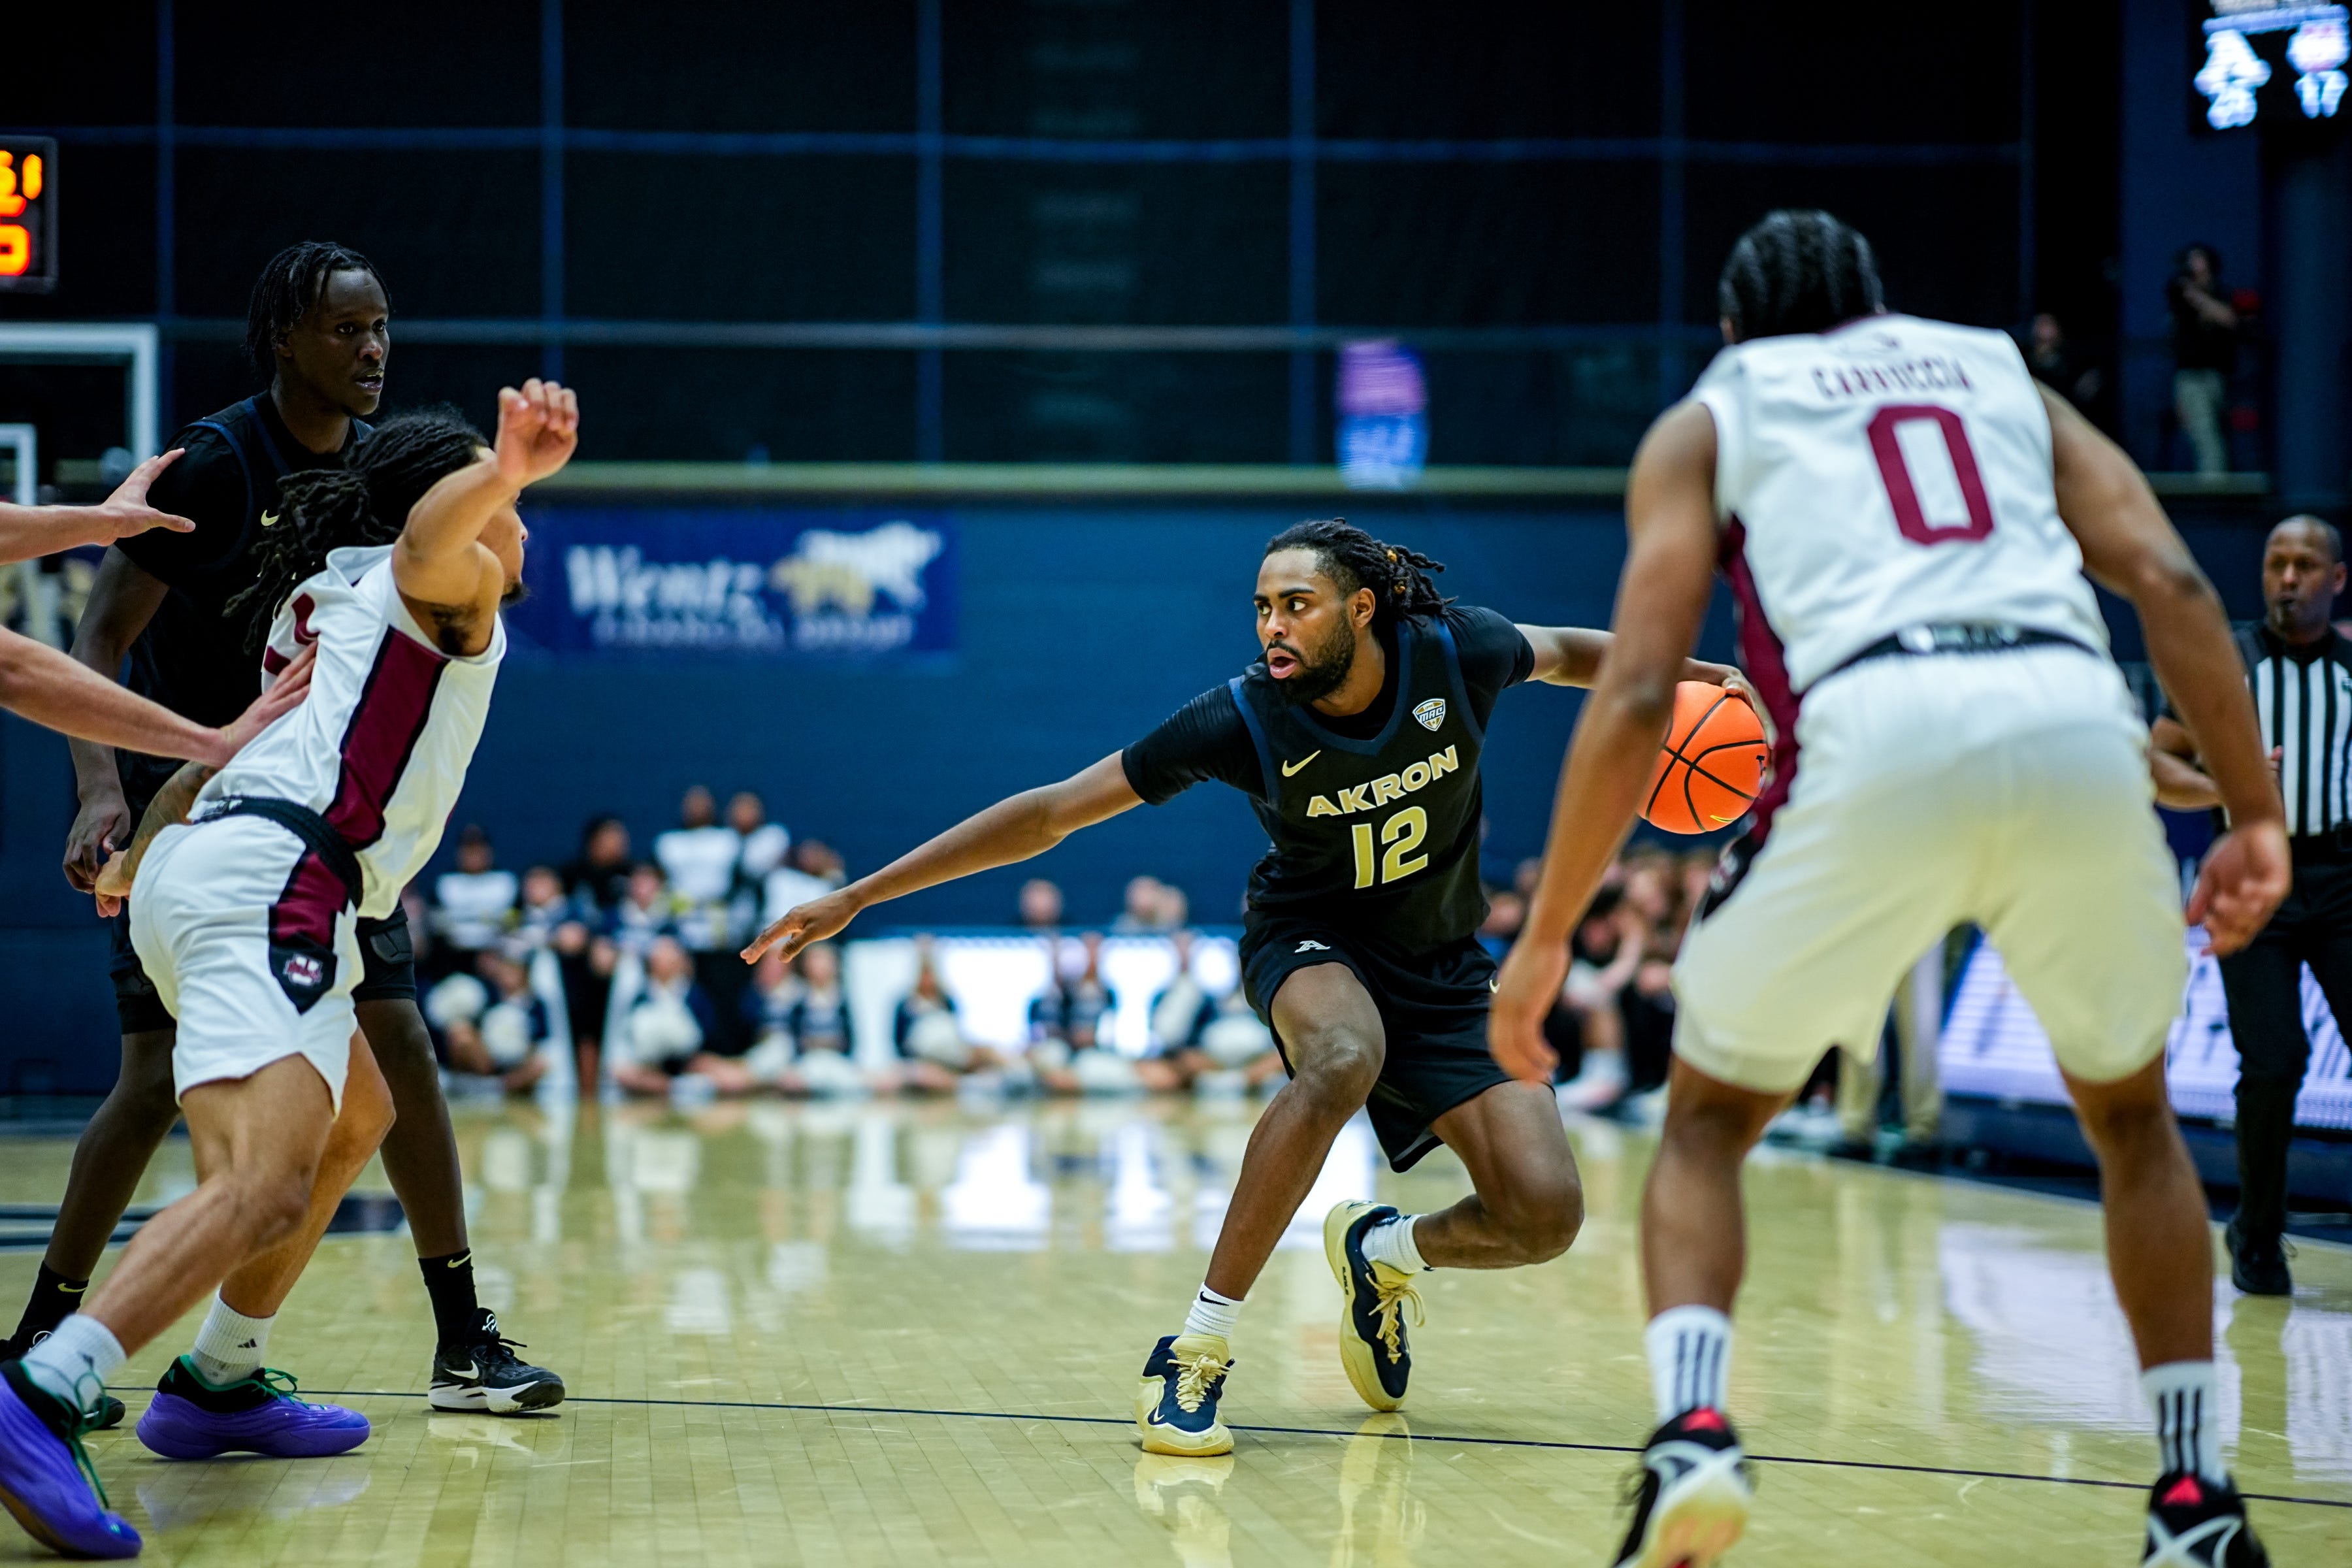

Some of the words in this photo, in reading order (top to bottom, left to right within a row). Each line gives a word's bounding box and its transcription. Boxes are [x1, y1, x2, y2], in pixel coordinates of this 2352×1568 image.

[1866, 404, 1995, 546] 0
[1418, 706, 1444, 723] MAC
[1306, 744, 1460, 818] AKRON
[1352, 805, 1429, 890] 12
